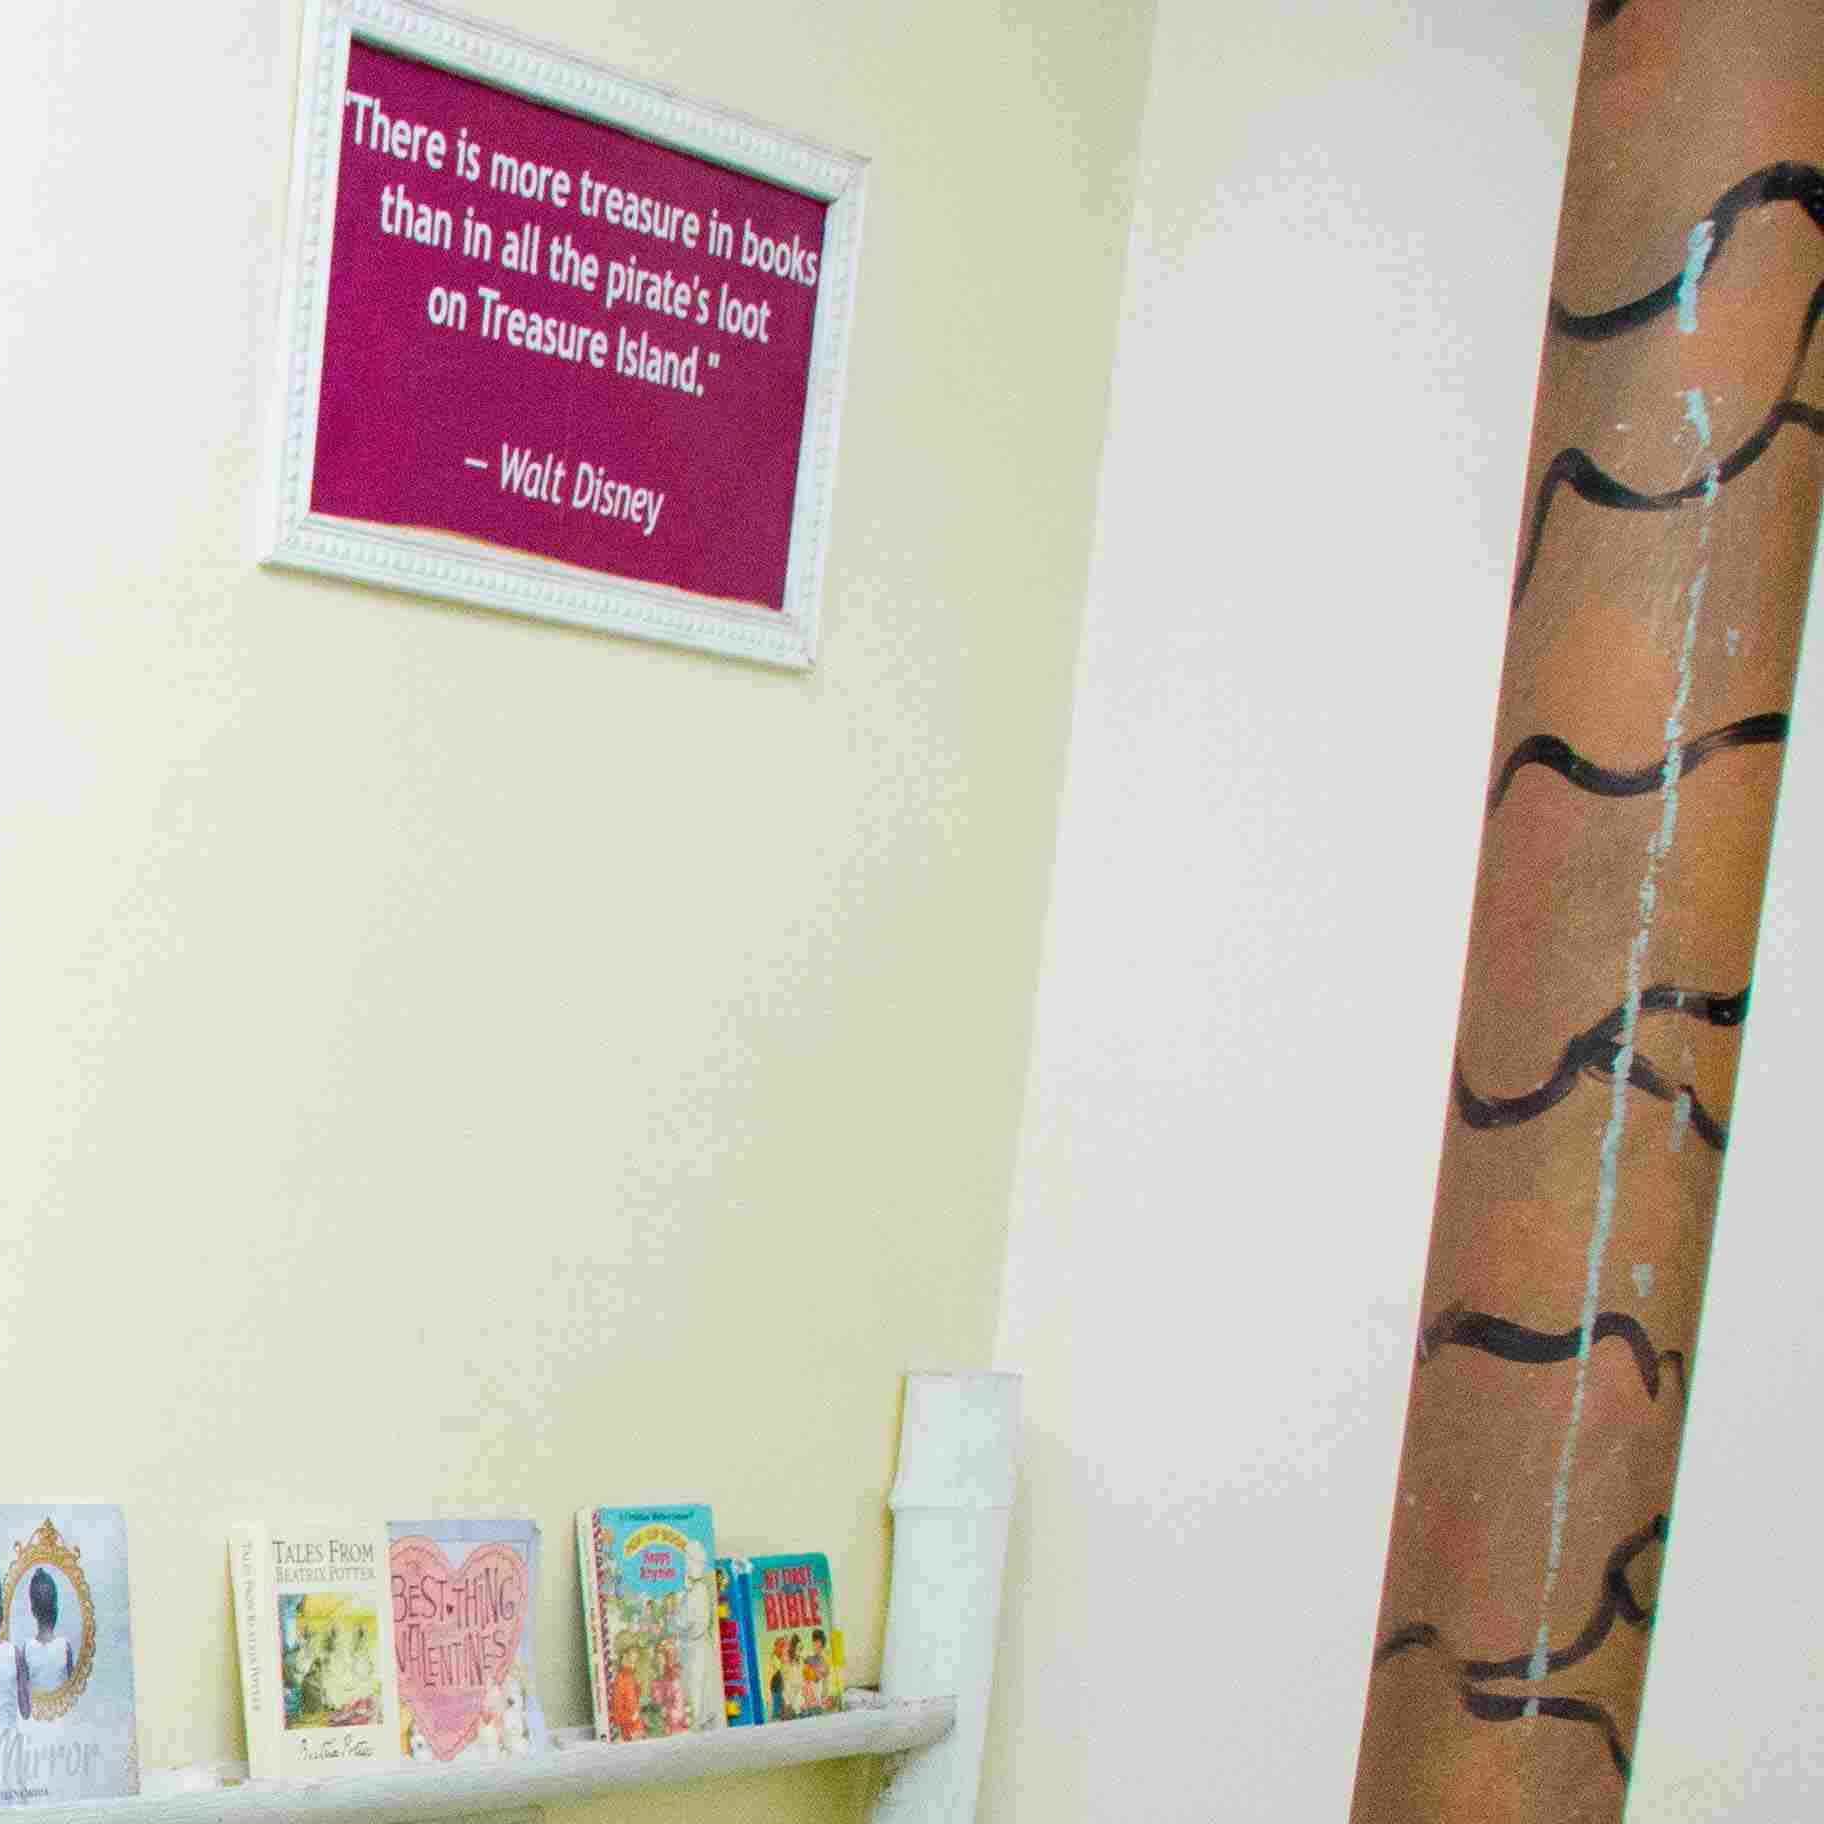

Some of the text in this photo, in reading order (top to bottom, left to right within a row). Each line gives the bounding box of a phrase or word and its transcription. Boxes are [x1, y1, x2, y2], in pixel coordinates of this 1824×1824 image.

[455, 127, 481, 183] is
[490, 150, 571, 208] more
[578, 169, 700, 251] treasure
[708, 208, 734, 262] in
[740, 217, 820, 289] books
[379, 183, 771, 345] than in all the pirate's loot
[428, 284, 466, 331] on
[477, 287, 609, 370] Treasure
[499, 442, 664, 537] Walt Disney
[272, 1540, 374, 1565] TALES FROM
[392, 1574, 447, 1623] BEST
[764, 1588, 822, 1631] BIBLE
